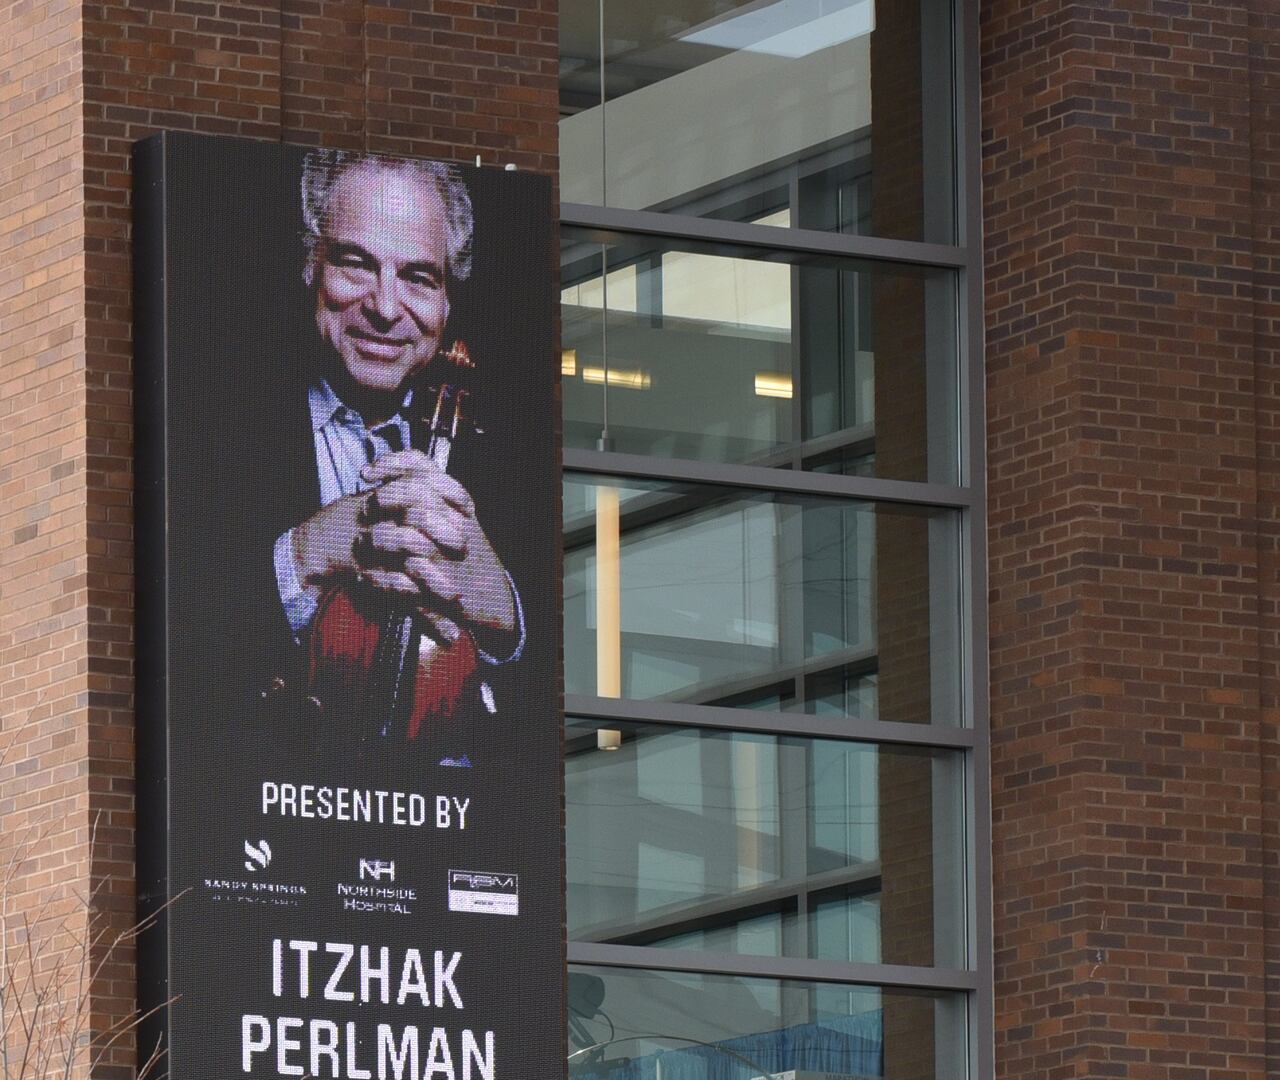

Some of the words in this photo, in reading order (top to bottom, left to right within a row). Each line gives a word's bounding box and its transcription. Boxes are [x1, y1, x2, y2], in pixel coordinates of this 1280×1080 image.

[262, 782, 425, 826] PRESENTED
[436, 795, 470, 829] BY
[337, 883, 417, 900] NORTHSIDE
[343, 898, 412, 914] HOSPITAL
[272, 938, 464, 1009] ITZHAK
